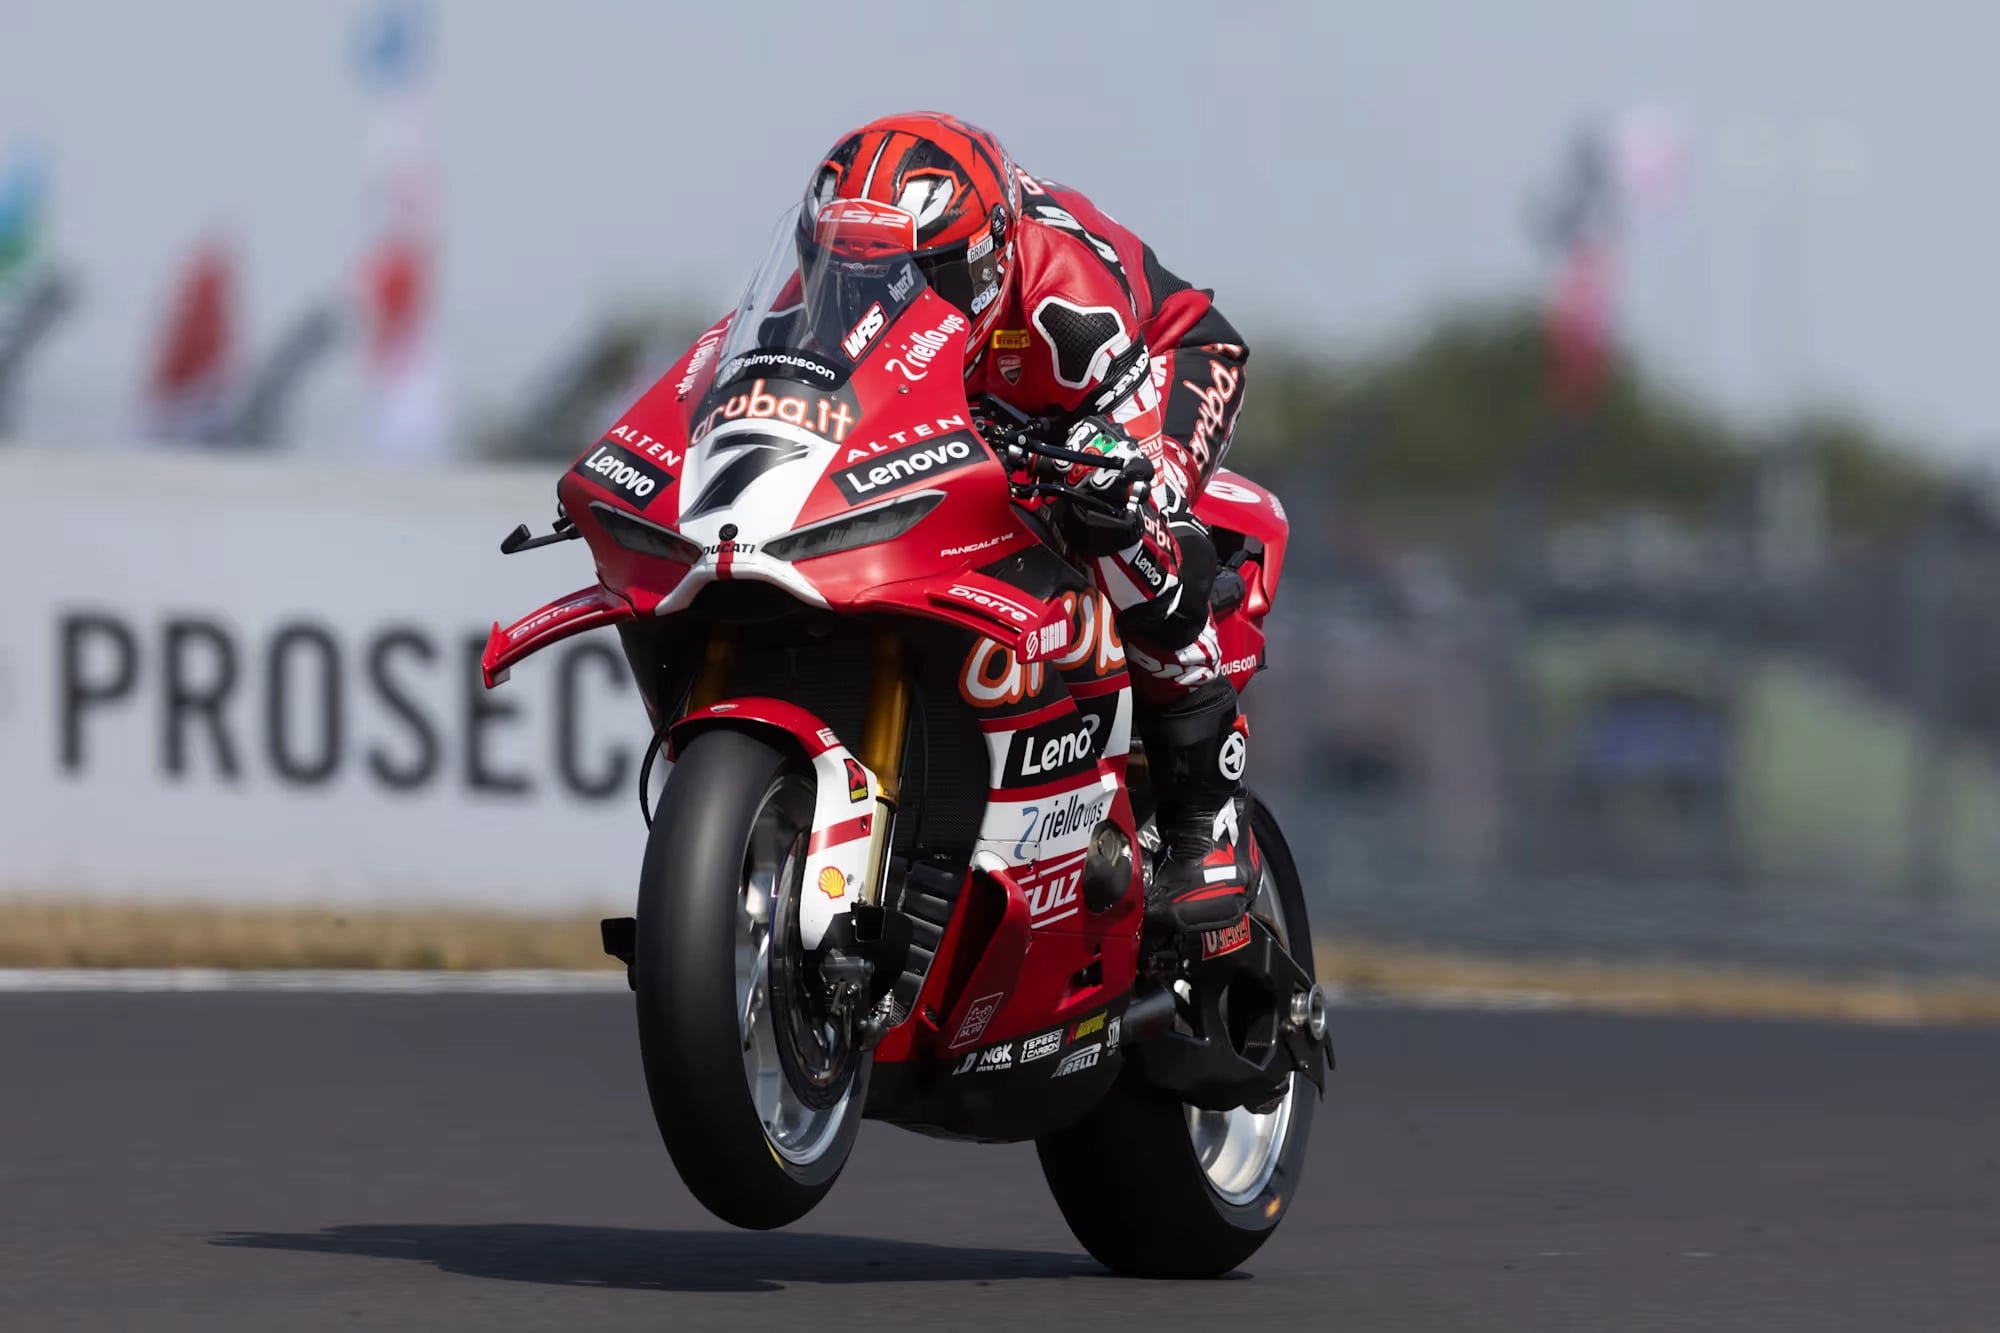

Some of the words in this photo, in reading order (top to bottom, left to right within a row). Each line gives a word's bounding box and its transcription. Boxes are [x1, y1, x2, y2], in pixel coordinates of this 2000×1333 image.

[820, 209, 910, 228] LS2
[901, 331, 949, 368] riello
[937, 314, 965, 334] ups
[690, 378, 854, 446] aruba.it
[611, 425, 681, 467] ALTEN
[847, 414, 965, 463] ALTEN
[584, 446, 656, 497] Lenovo
[676, 432, 810, 525] 7
[846, 441, 970, 494] Lenovo
[703, 543, 756, 556] DUCATI
[940, 538, 999, 558] PANIGALE
[947, 587, 1028, 622] Dierre
[58, 611, 634, 803] PROSEC
[1021, 713, 1100, 776] Leno
[1039, 794, 1084, 842] riello
[1084, 801, 1103, 833] ups
[979, 1043, 1013, 1065] NGK
